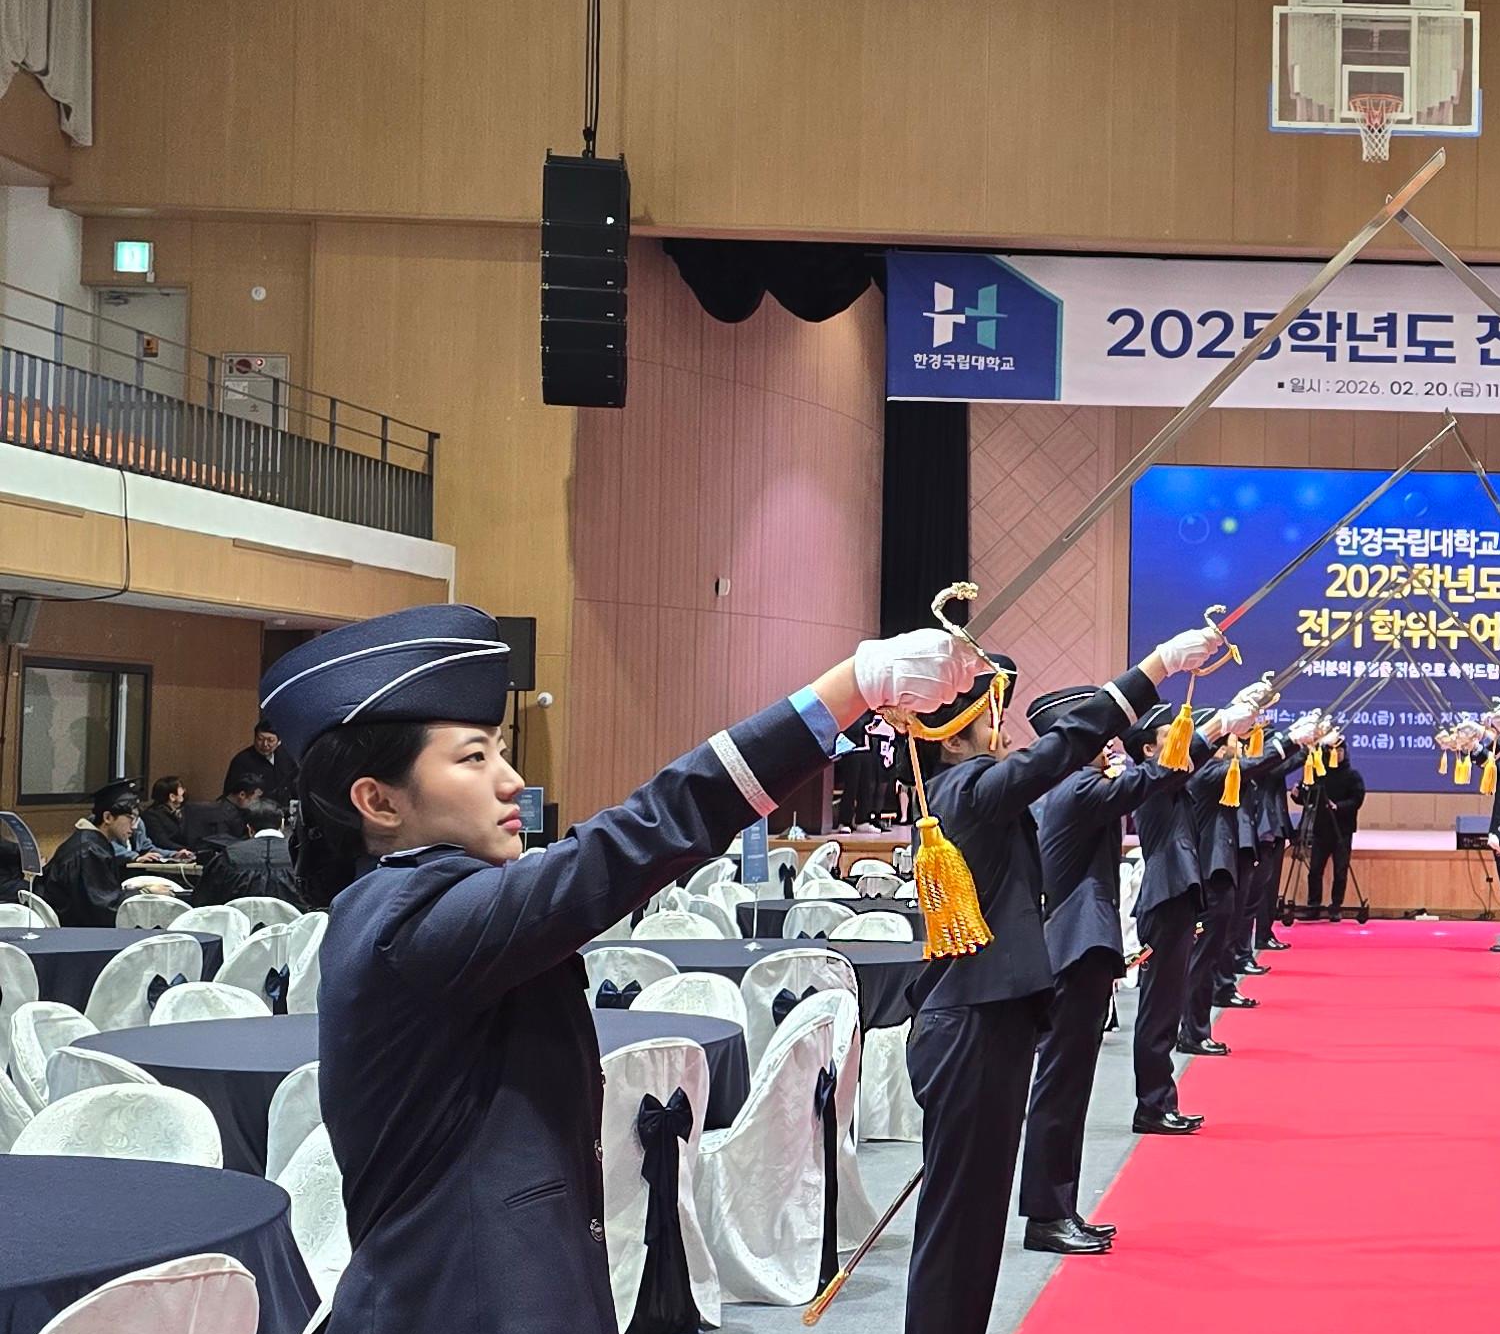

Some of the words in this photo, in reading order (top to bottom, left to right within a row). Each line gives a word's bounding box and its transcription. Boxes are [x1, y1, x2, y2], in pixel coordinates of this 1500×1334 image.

[1106, 308, 1456, 364] 2025학년도
[913, 353, 1015, 372] 한경국립대학교
[1296, 608, 1364, 649] 전기
